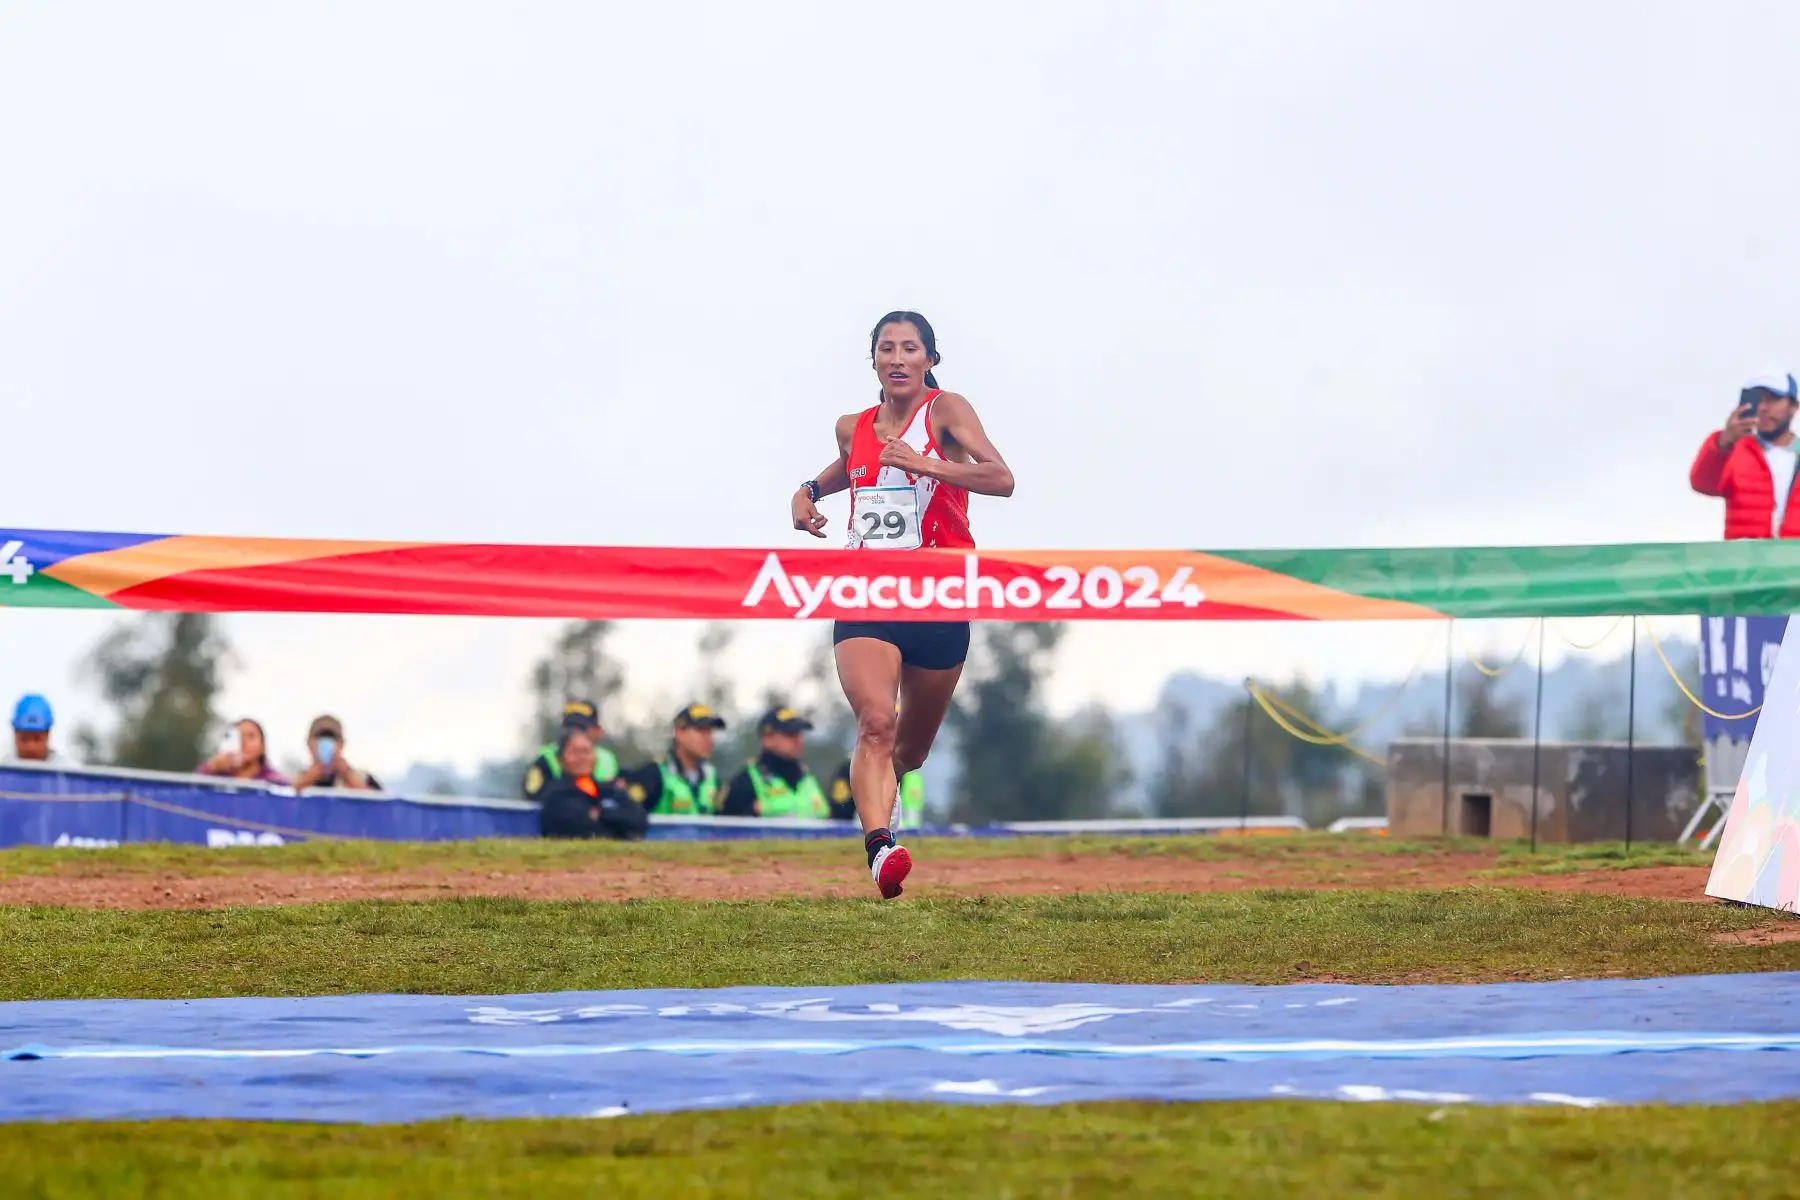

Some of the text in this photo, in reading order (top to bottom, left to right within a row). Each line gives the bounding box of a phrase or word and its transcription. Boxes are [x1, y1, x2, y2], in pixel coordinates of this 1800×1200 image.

[861, 511, 906, 540] 29
[742, 552, 1207, 619] Ayacucho 2024
